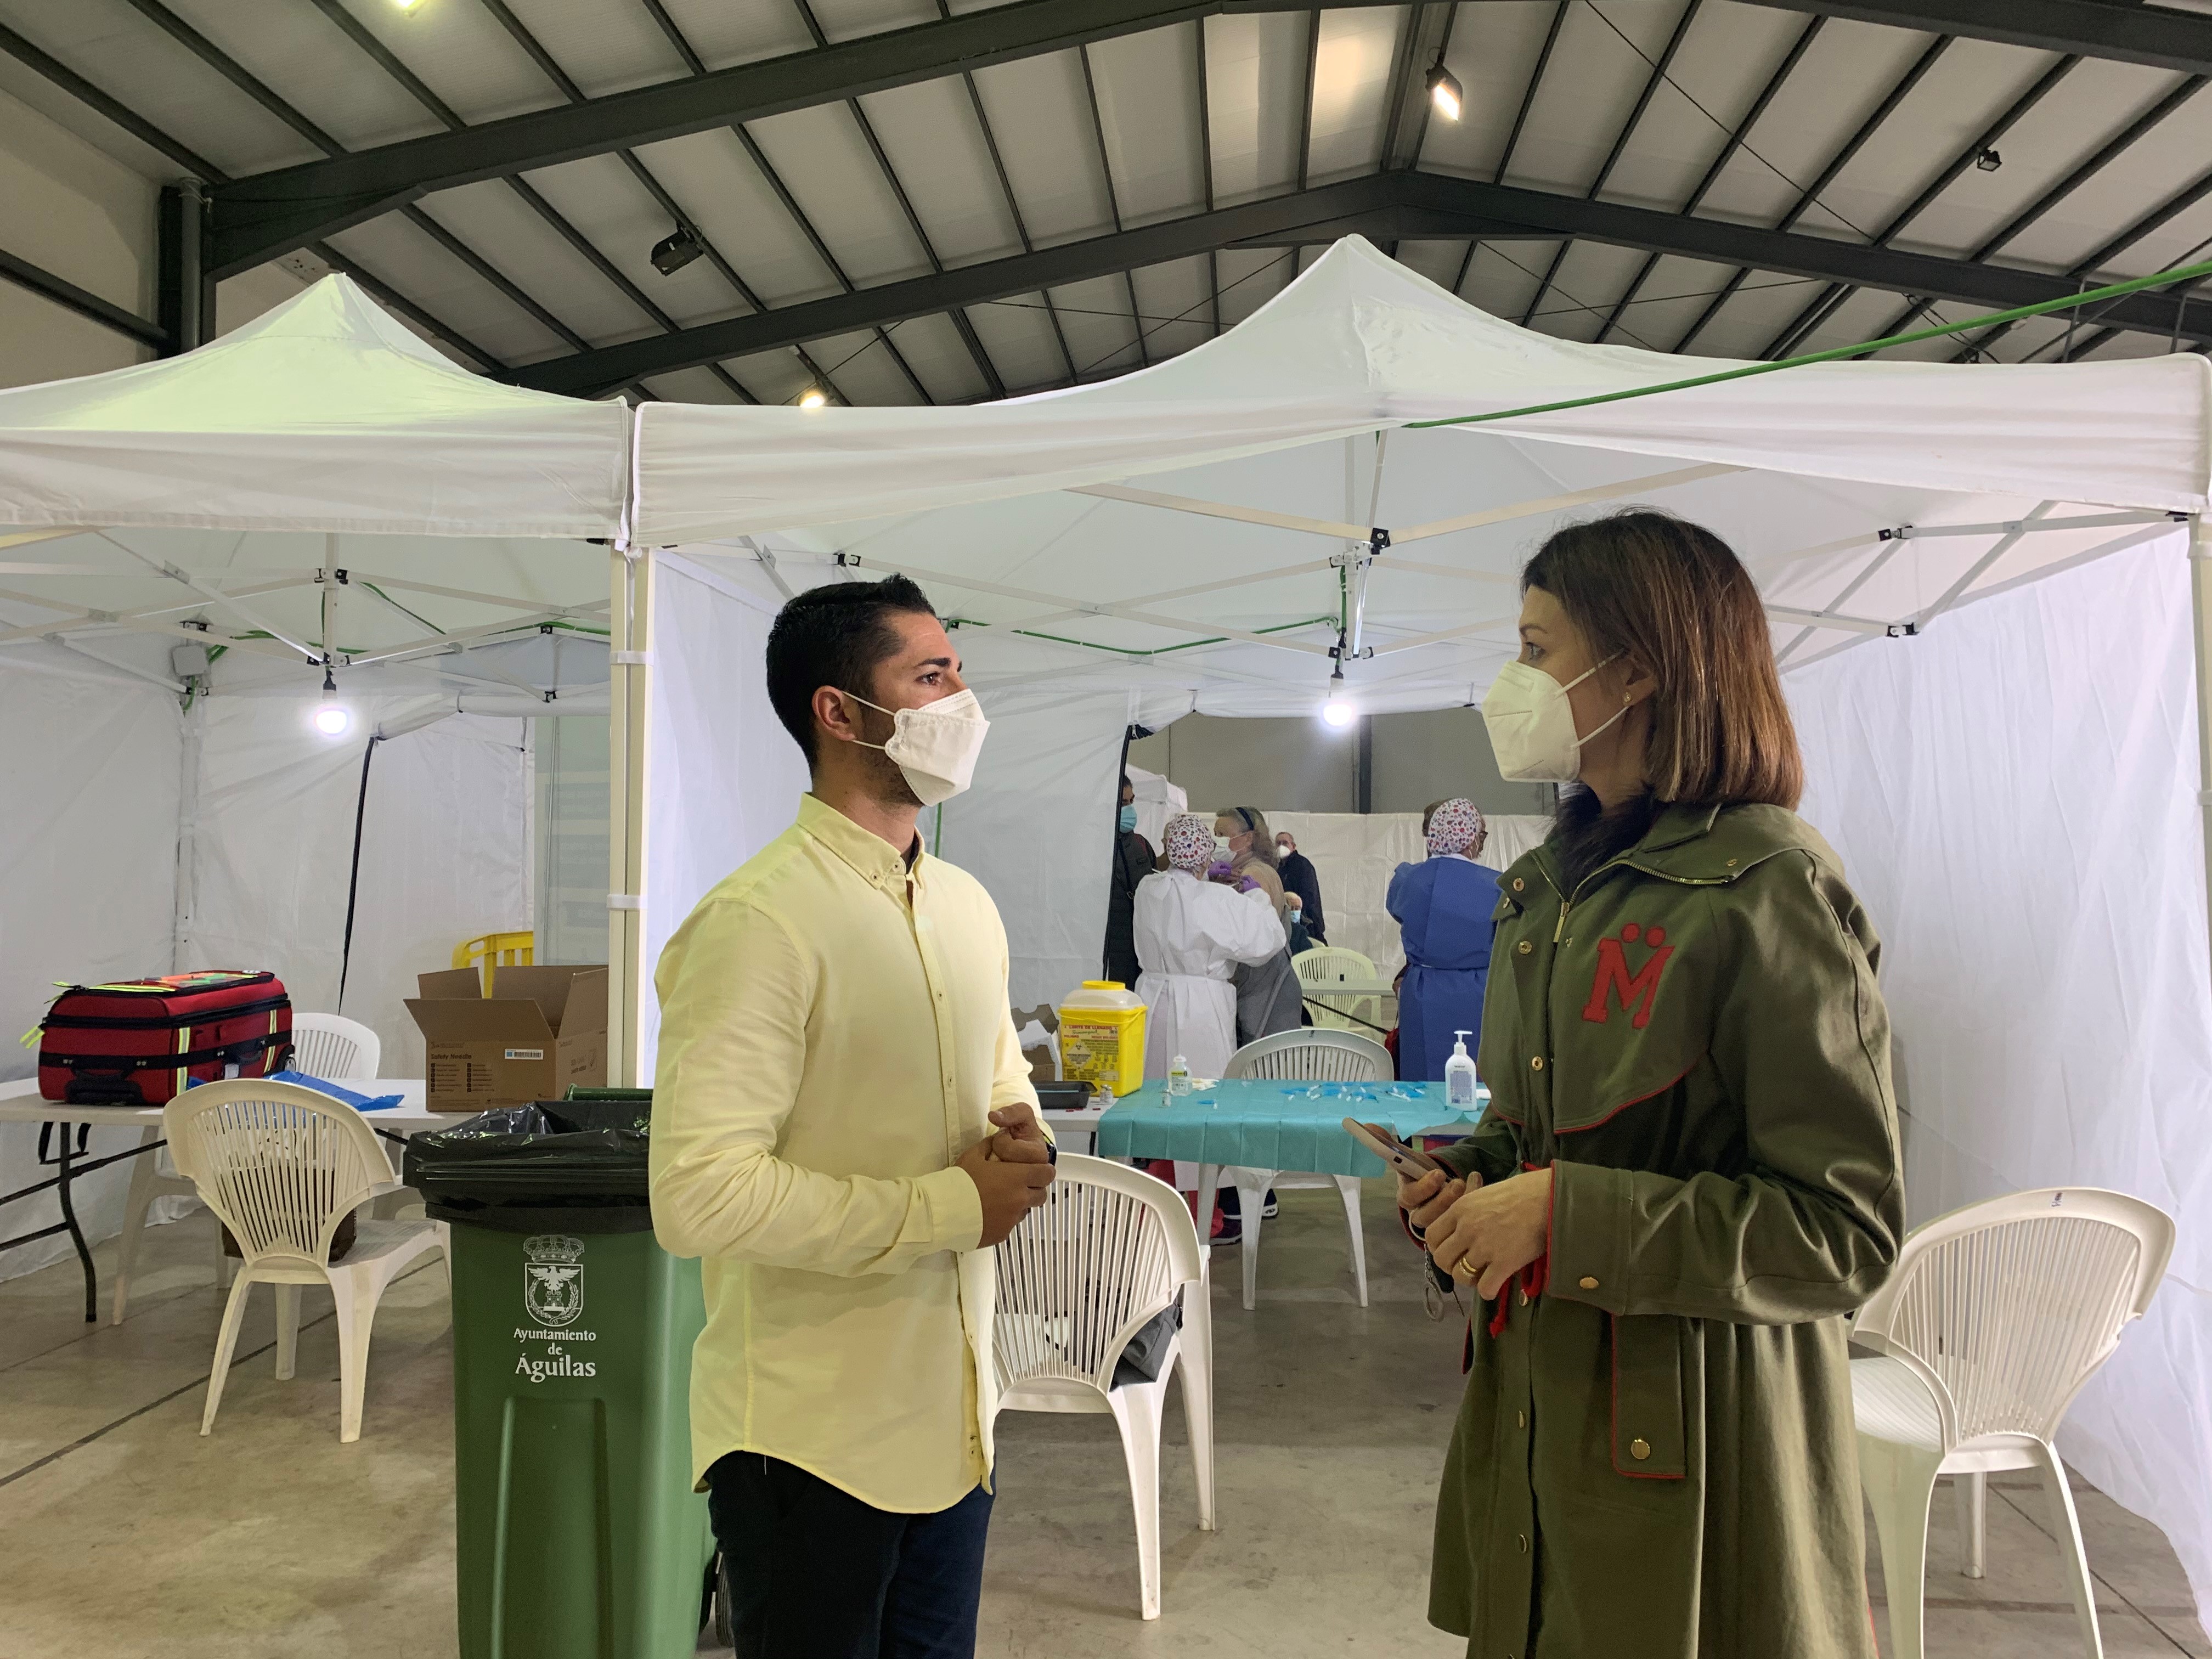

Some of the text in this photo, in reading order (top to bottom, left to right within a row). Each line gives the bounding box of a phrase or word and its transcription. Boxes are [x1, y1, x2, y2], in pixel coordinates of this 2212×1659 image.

[514, 1328, 597, 1343] Ayuntamiento
[548, 1342, 563, 1355] de
[515, 1353, 596, 1383] Águilas
